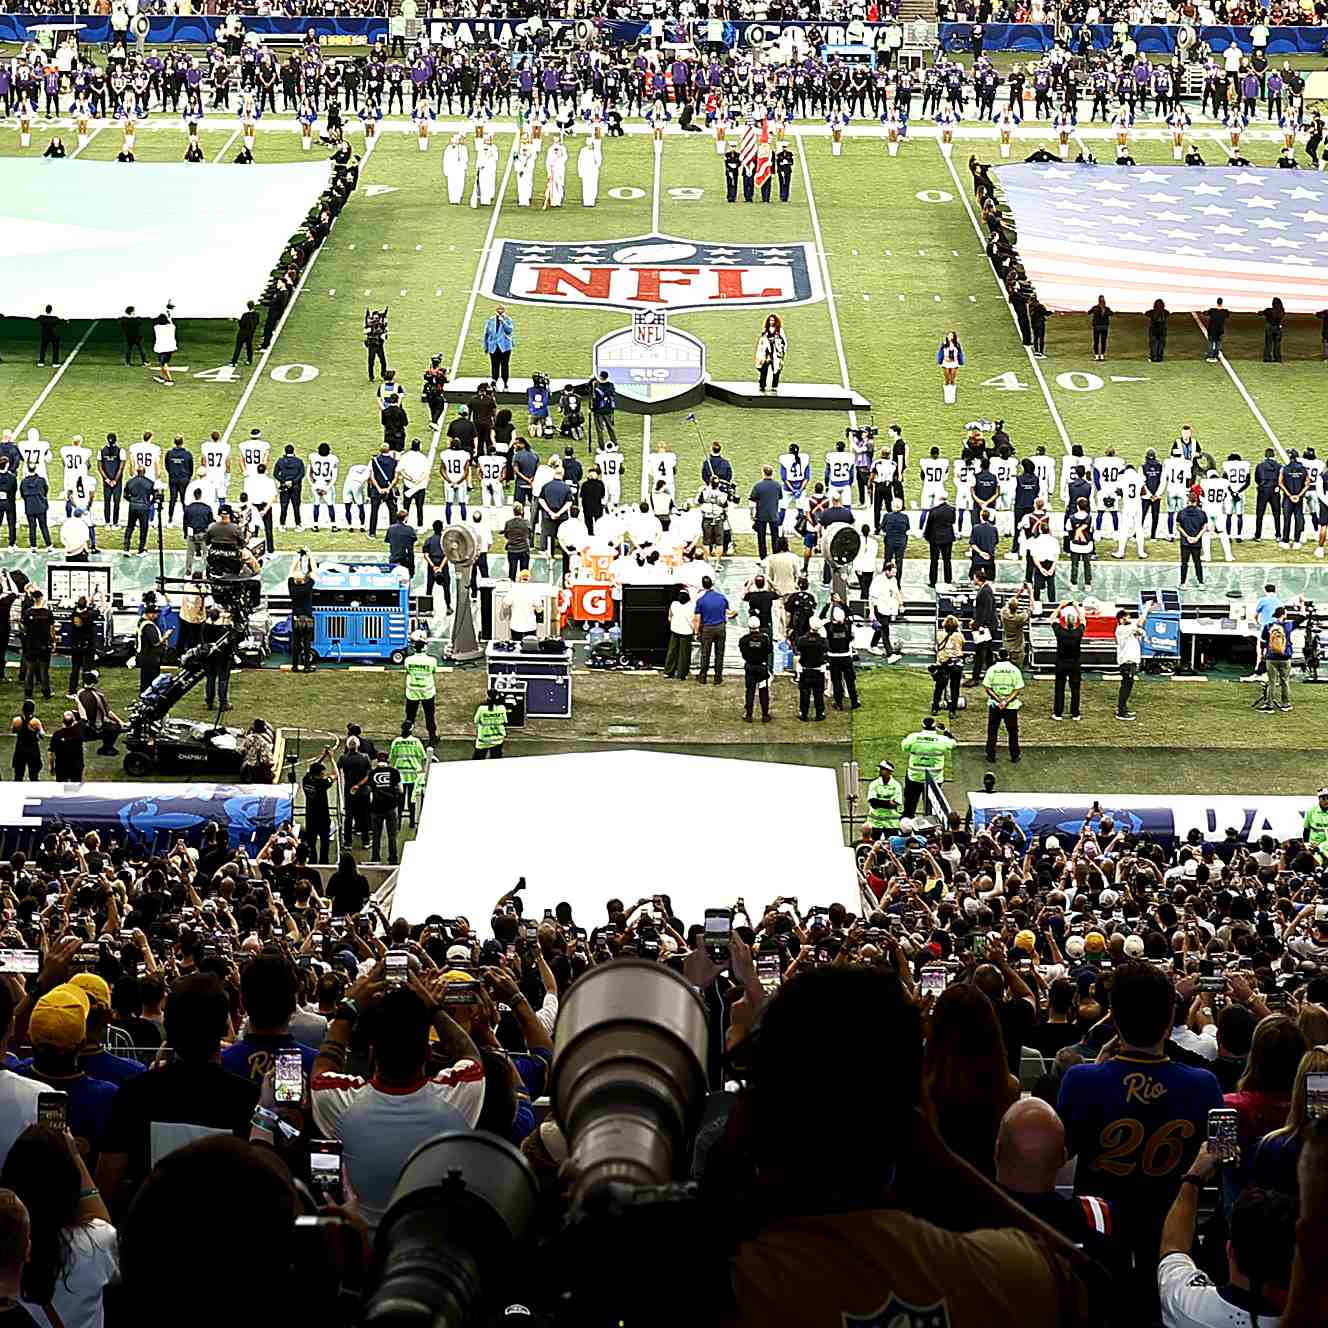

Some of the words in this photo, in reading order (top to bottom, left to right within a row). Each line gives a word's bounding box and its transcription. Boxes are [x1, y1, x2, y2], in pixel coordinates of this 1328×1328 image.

[525, 266, 783, 304] NFL
[637, 325, 663, 343] NFL
[629, 368, 670, 378] RIO
[980, 370, 1105, 392] 40
[25, 449, 41, 464] 77
[136, 451, 152, 467] 86
[207, 452, 223, 467] 87
[245, 449, 261, 465] 89
[313, 460, 331, 476] 33
[447, 458, 462, 474] 18
[483, 463, 499, 479] 32
[603, 459, 617, 475] 19
[658, 460, 666, 476] 4
[834, 462, 849, 477] 23
[997, 466, 1010, 481] 21
[926, 467, 942, 482] 50
[1102, 467, 1118, 482] 40
[1170, 468, 1184, 484] 14
[1230, 468, 1246, 484] 26
[1128, 483, 1136, 499] 3
[582, 589, 608, 616] G
[1122, 1072, 1168, 1105] Rio
[1087, 1117, 1196, 1177] 26
